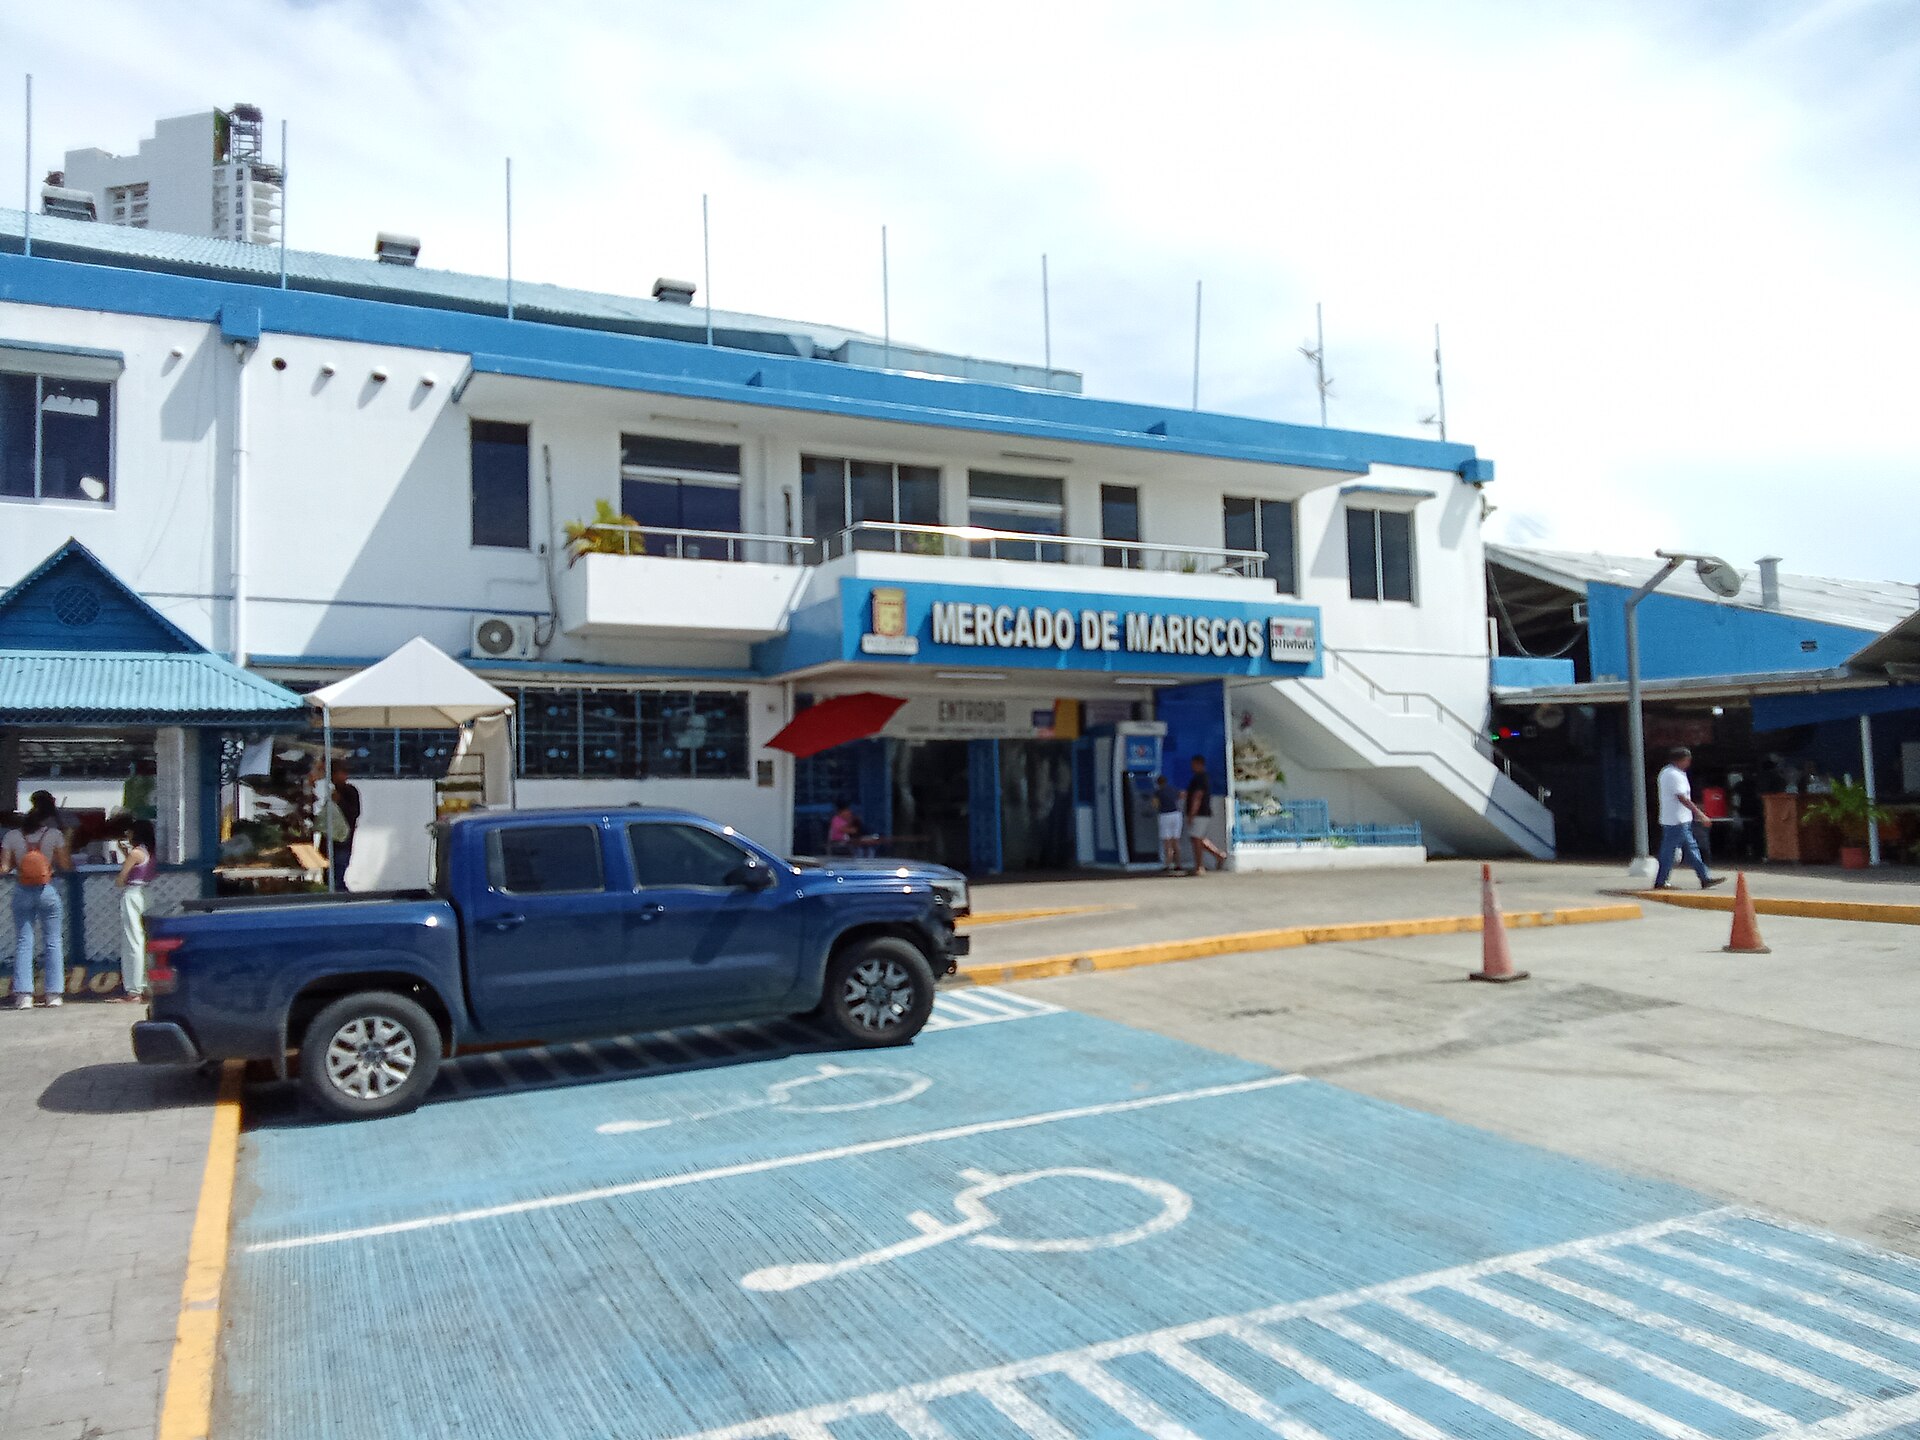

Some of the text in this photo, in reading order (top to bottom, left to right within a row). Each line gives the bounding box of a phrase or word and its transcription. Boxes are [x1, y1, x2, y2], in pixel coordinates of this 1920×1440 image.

[932, 601, 1264, 657] MERCADO DE MARISCOS
